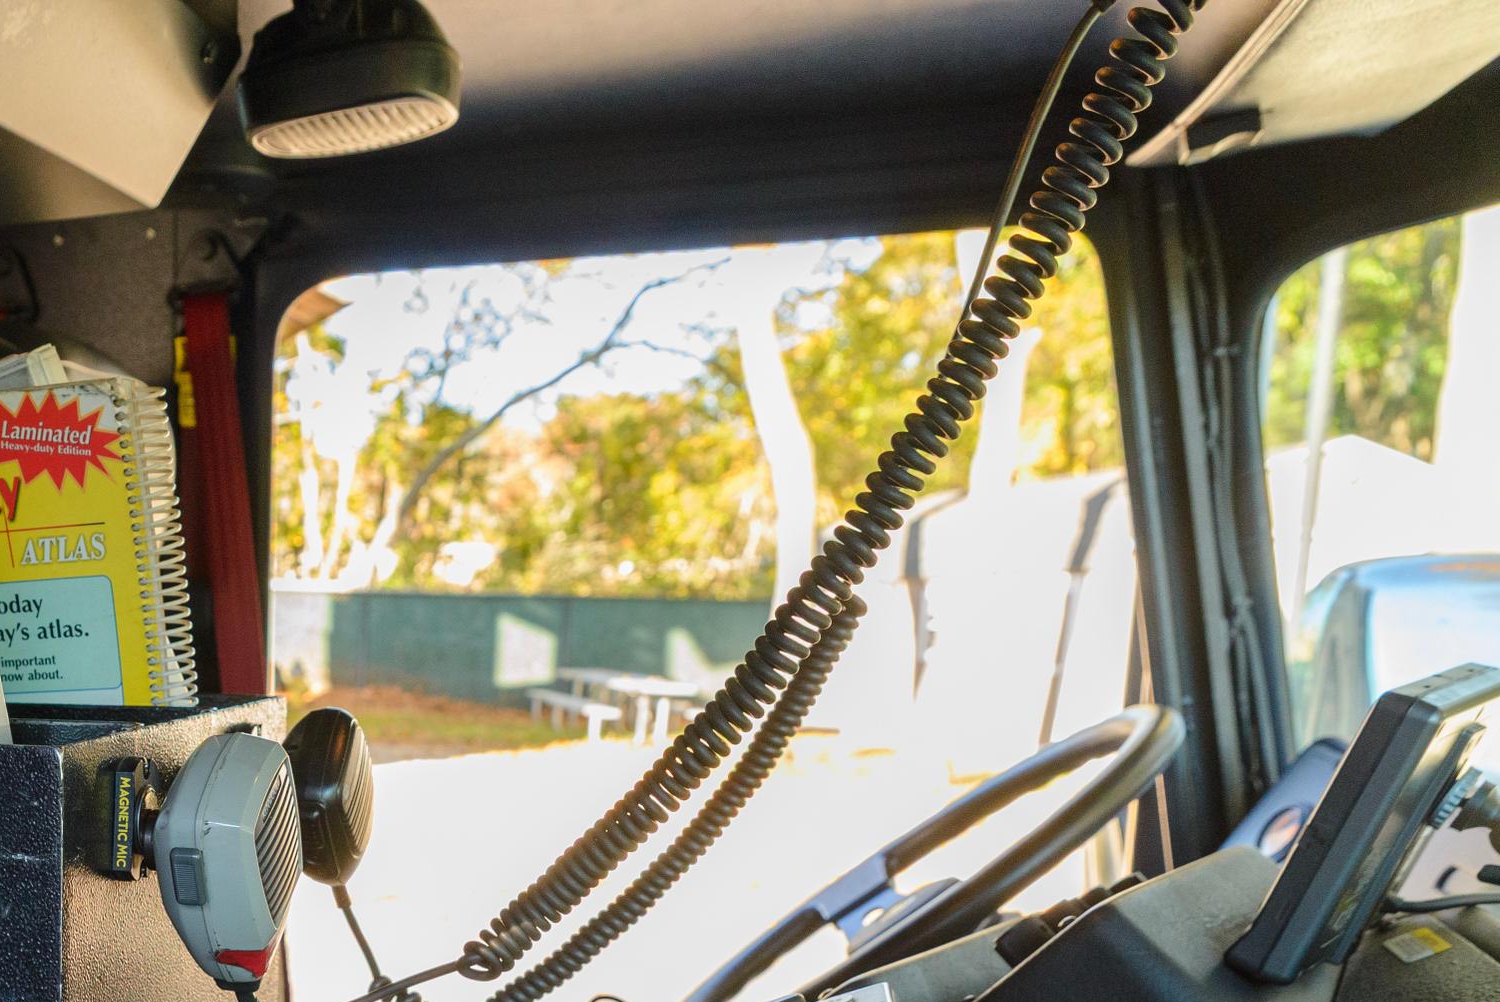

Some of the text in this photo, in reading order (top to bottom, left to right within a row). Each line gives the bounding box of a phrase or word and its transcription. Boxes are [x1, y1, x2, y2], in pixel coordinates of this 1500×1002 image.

[1, 421, 92, 444] Laminated
[1, 440, 92, 456] Heavy-duty Edition
[21, 533, 106, 566] ATLAS
[37, 619, 90, 640] atlas.
[1, 656, 57, 670] important
[27, 669, 64, 681] about.
[116, 776, 131, 868] MAGNETIC MIC
